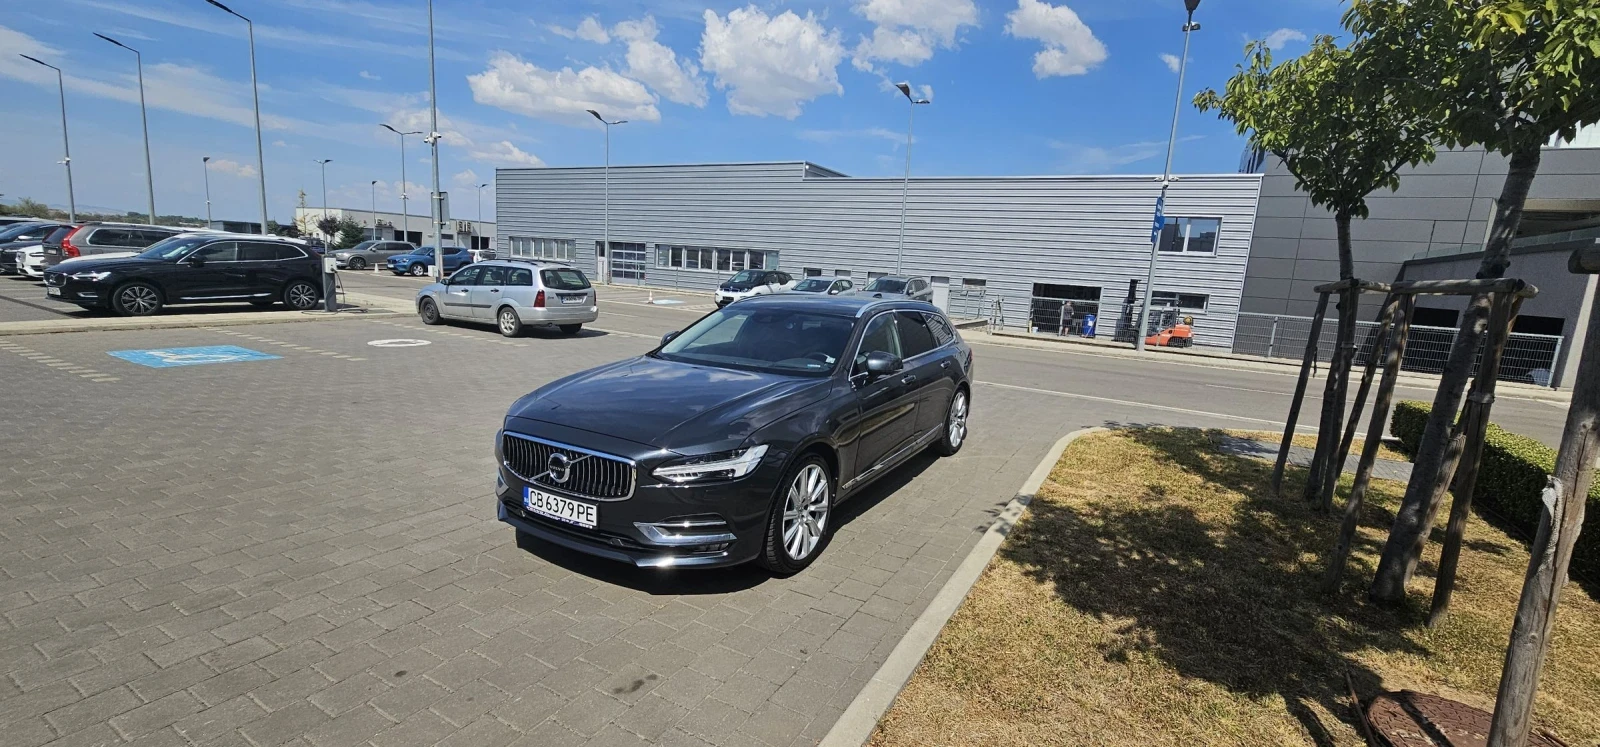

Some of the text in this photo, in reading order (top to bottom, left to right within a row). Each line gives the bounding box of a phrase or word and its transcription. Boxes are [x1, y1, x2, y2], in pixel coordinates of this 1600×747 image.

[530, 490, 543, 508] CB
[546, 495, 574, 517] 6379
[577, 504, 594, 522] PE
